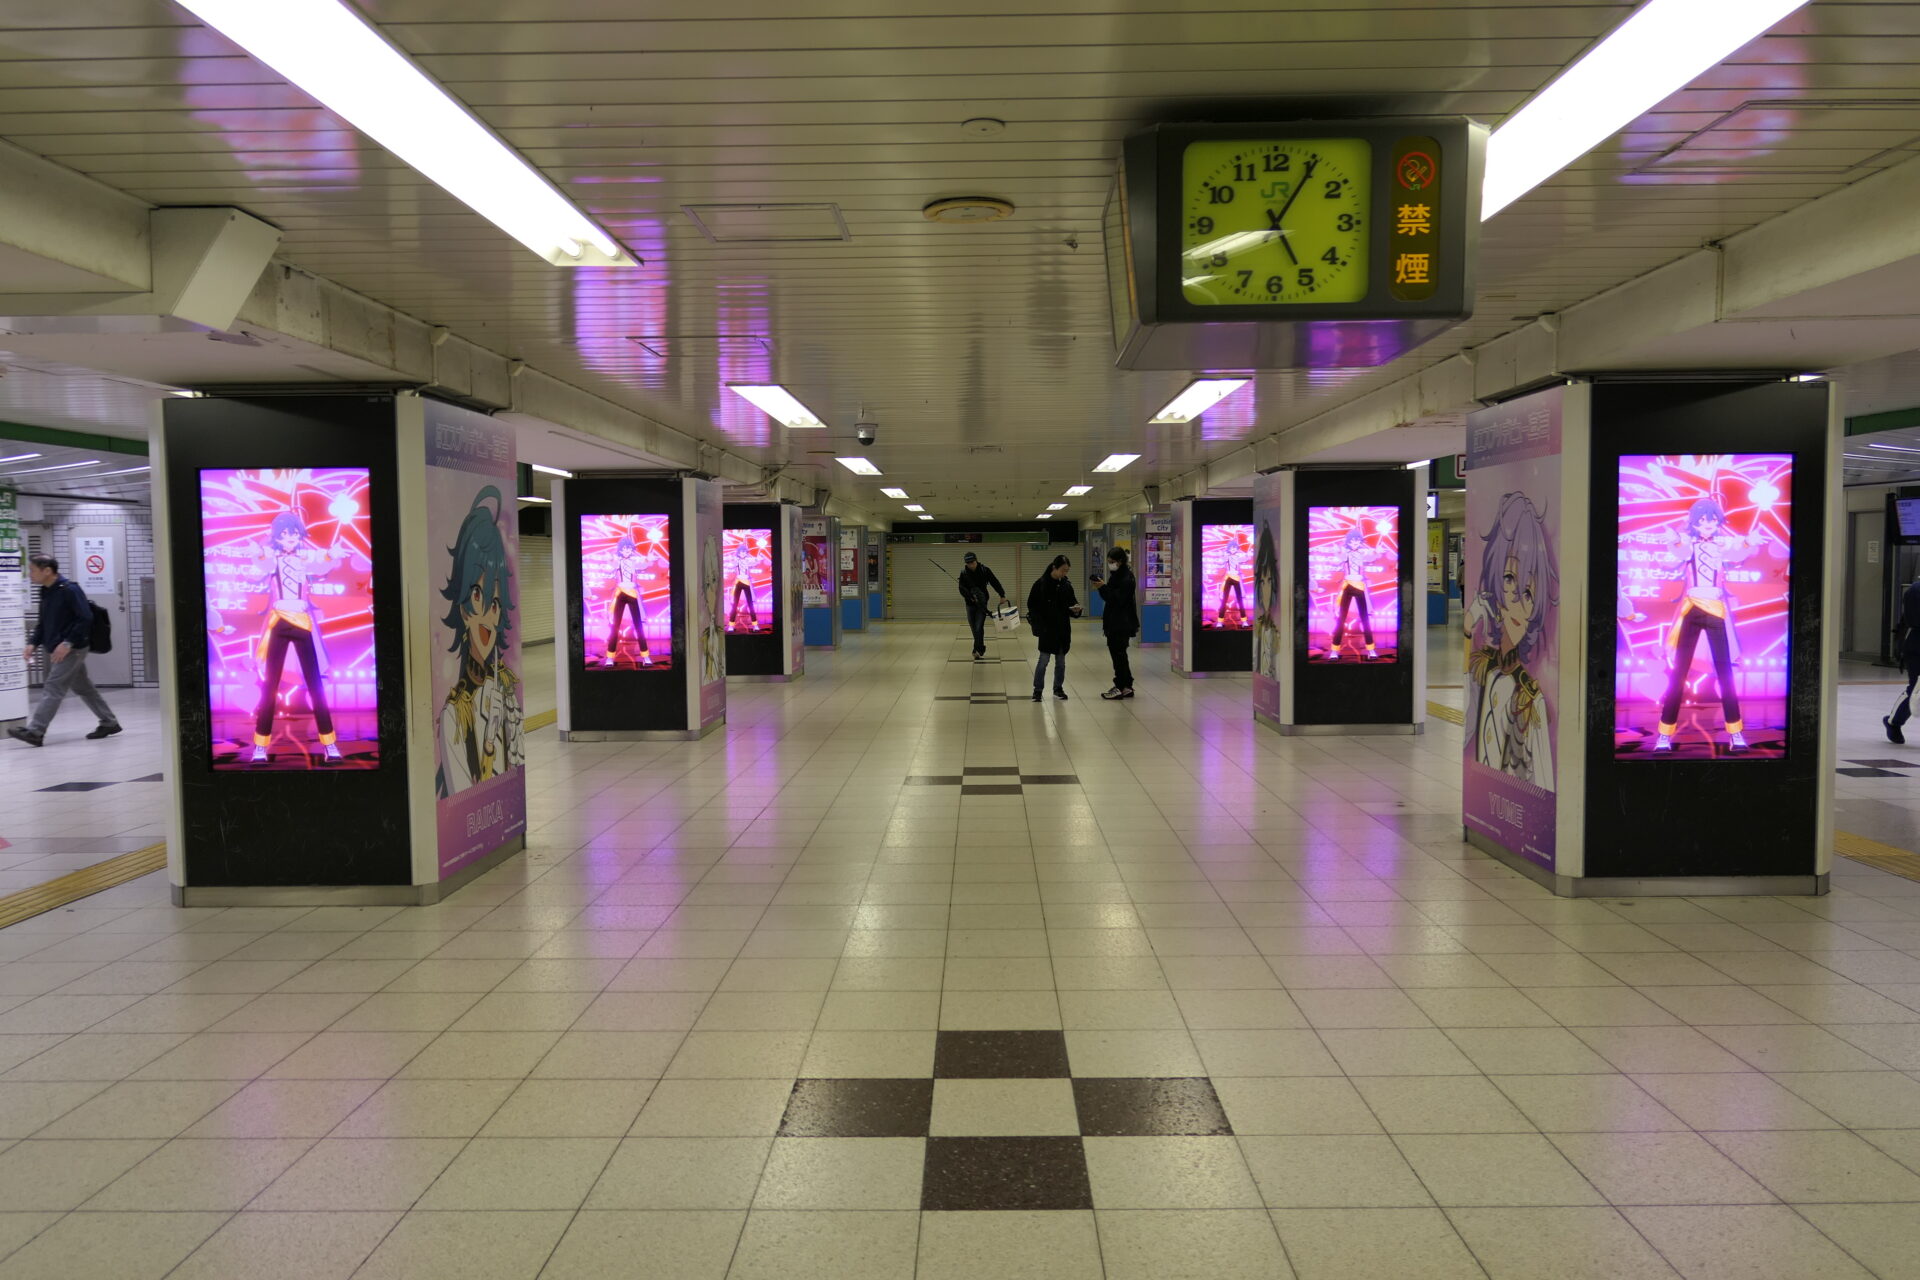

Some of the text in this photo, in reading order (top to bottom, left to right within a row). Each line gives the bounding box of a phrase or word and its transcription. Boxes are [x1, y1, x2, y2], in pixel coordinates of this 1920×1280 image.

[1233, 163, 1257, 181] 11
[1263, 154, 1289, 172] 12
[1209, 186, 1234, 204] 10
[1261, 182, 1290, 199] JR
[1324, 181, 1342, 199] 2
[1196, 216, 1214, 234] 9
[1337, 213, 1354, 232] 3
[1396, 203, 1431, 284] 禁煙
[1321, 246, 1340, 265] 4
[1236, 270, 1253, 288] 7
[1266, 276, 1283, 294] 6
[1297, 268, 1315, 287] 5
[466, 799, 504, 838] RAIKA
